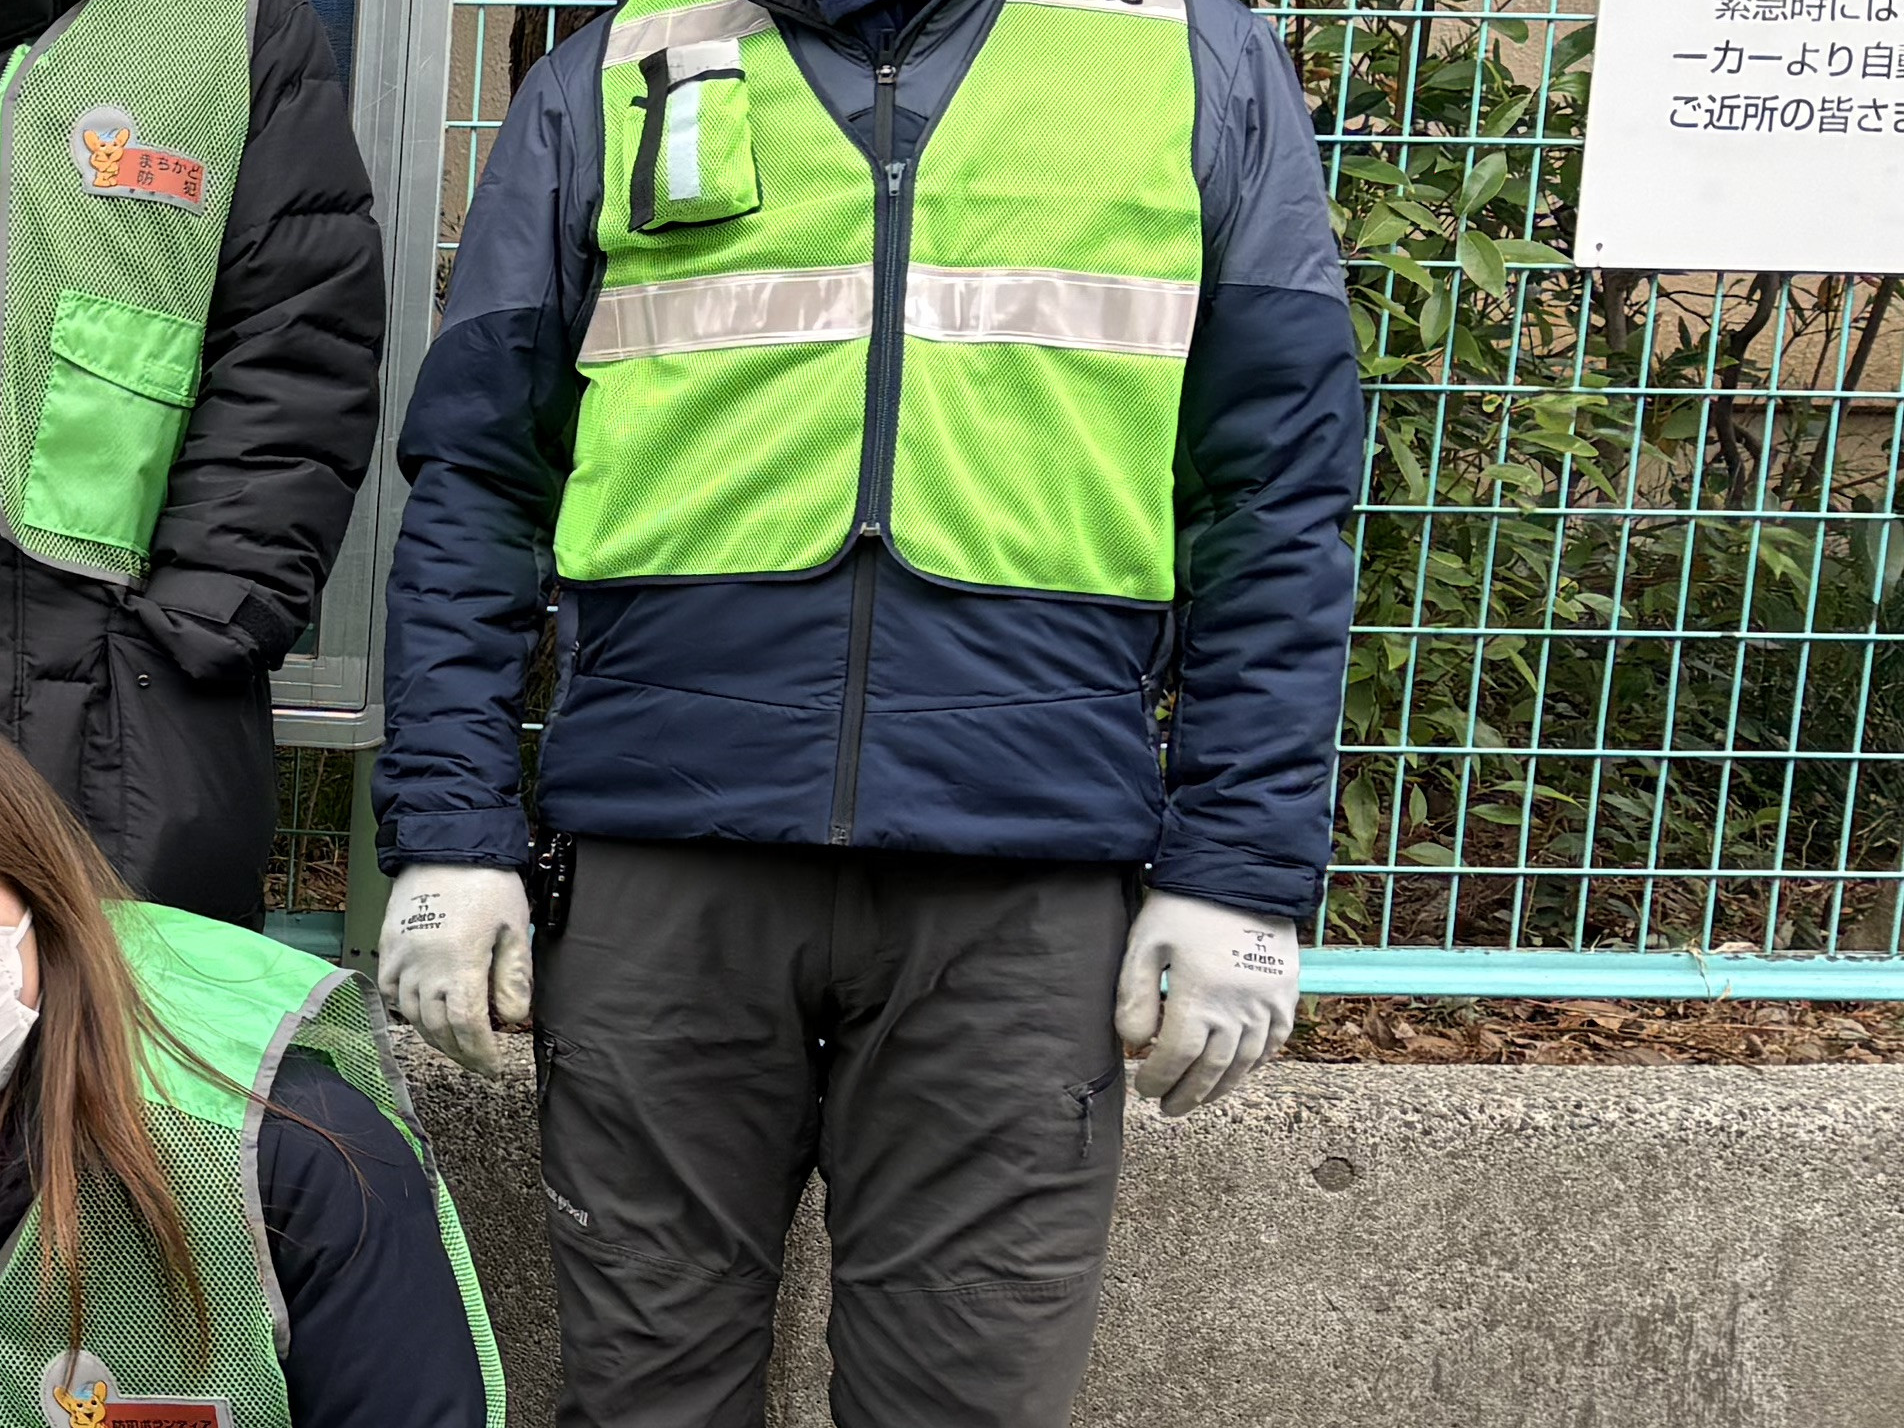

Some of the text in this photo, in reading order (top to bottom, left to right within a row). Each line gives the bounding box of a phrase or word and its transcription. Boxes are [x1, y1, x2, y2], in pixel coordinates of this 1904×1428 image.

[139, 154, 200, 180] まちかど
[1243, 953, 1276, 965] GRIP
